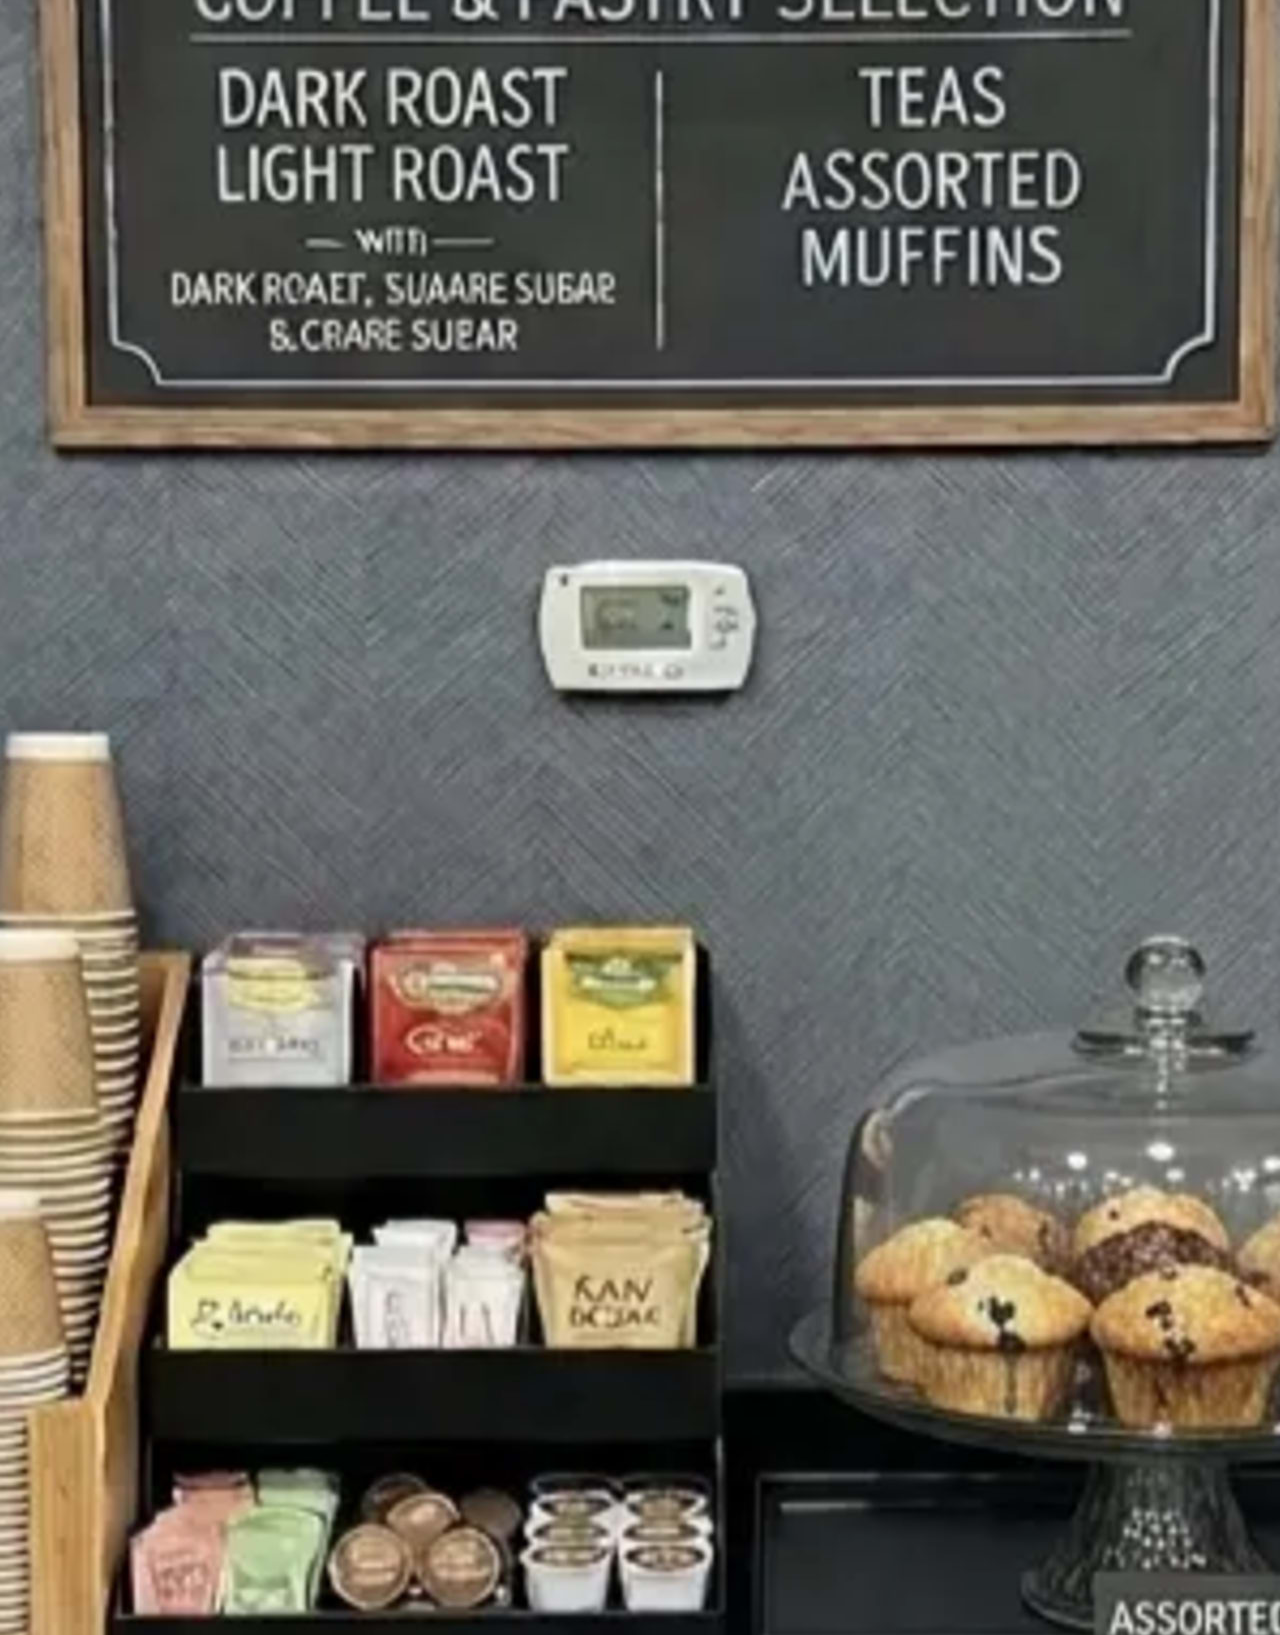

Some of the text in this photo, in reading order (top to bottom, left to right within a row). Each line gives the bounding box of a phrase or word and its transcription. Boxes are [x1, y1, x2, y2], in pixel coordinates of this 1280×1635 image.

[219, 67, 567, 128] DARK ROAST
[859, 66, 1006, 127] TEAS
[218, 143, 569, 203] LIGHT ROAST
[782, 149, 1080, 210] ASSORTED
[803, 225, 1062, 286] MUFFINS
[171, 271, 256, 306] DARK
